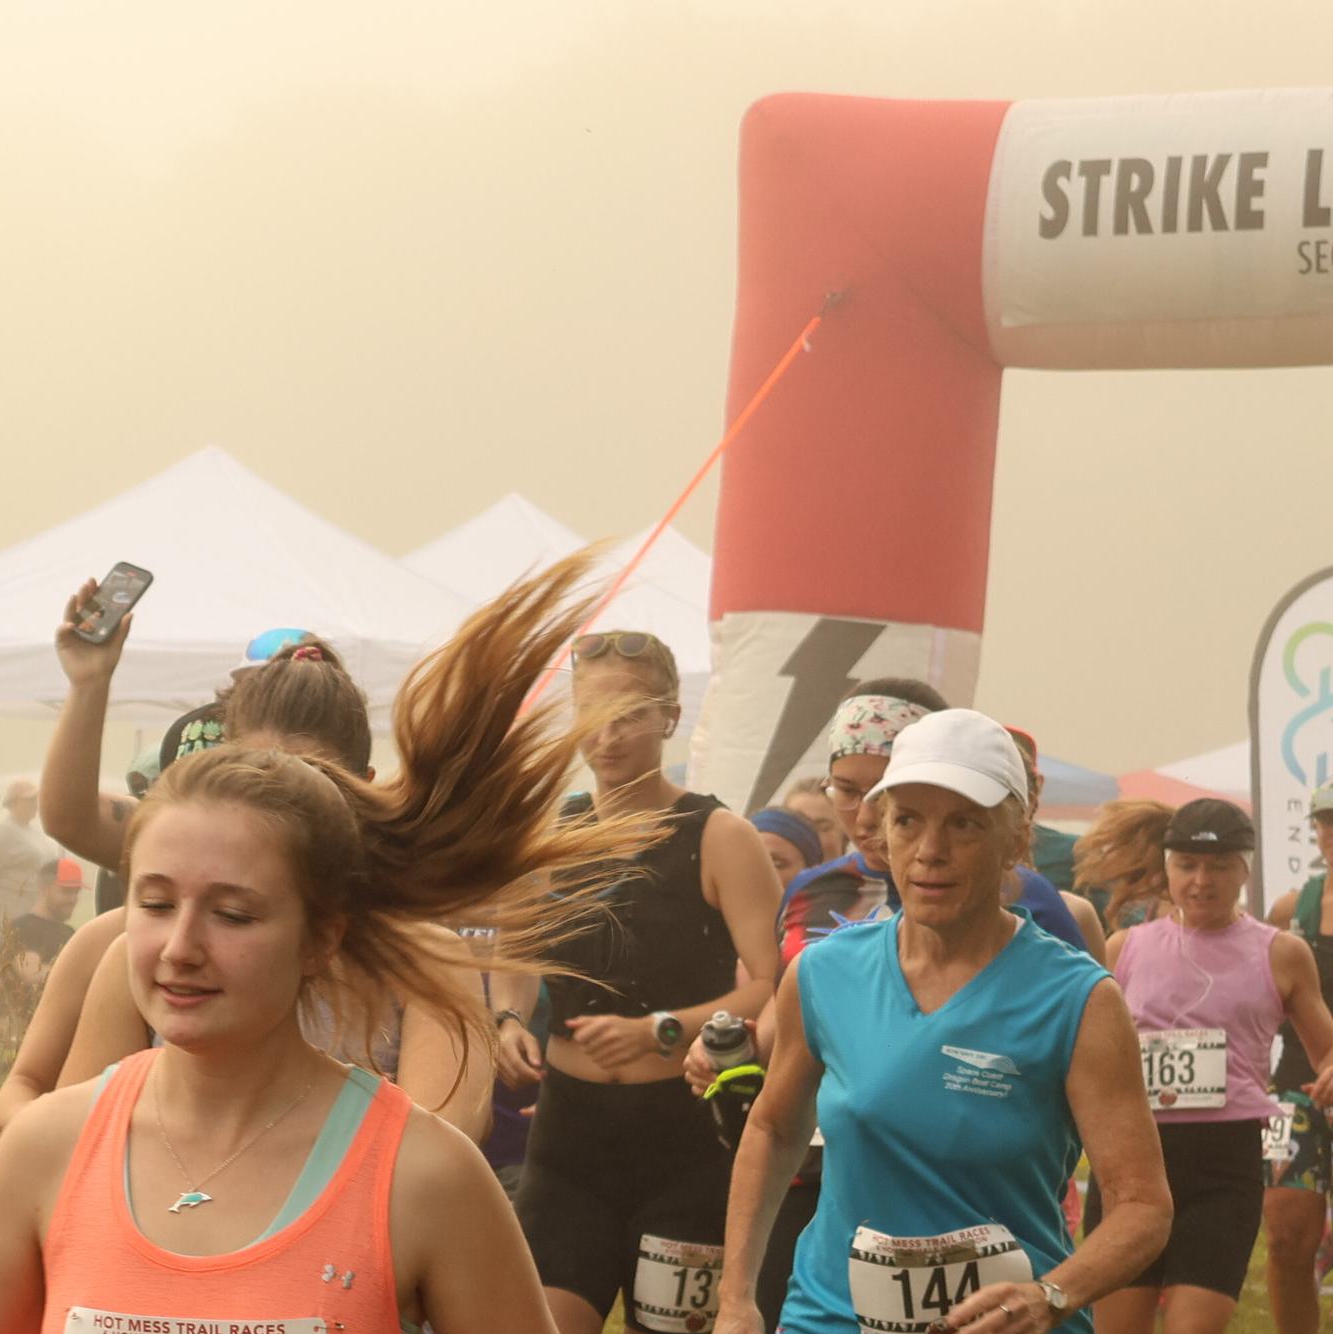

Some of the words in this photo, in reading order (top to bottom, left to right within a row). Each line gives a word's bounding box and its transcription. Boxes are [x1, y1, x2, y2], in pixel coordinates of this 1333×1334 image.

[1039, 152, 1269, 240] STRIKE
[1297, 240, 1333, 275] SE
[1143, 1051, 1195, 1086] 163
[673, 1267, 722, 1309] 13
[94, 1315, 125, 1330] HOT
[128, 1319, 171, 1334] MESS
